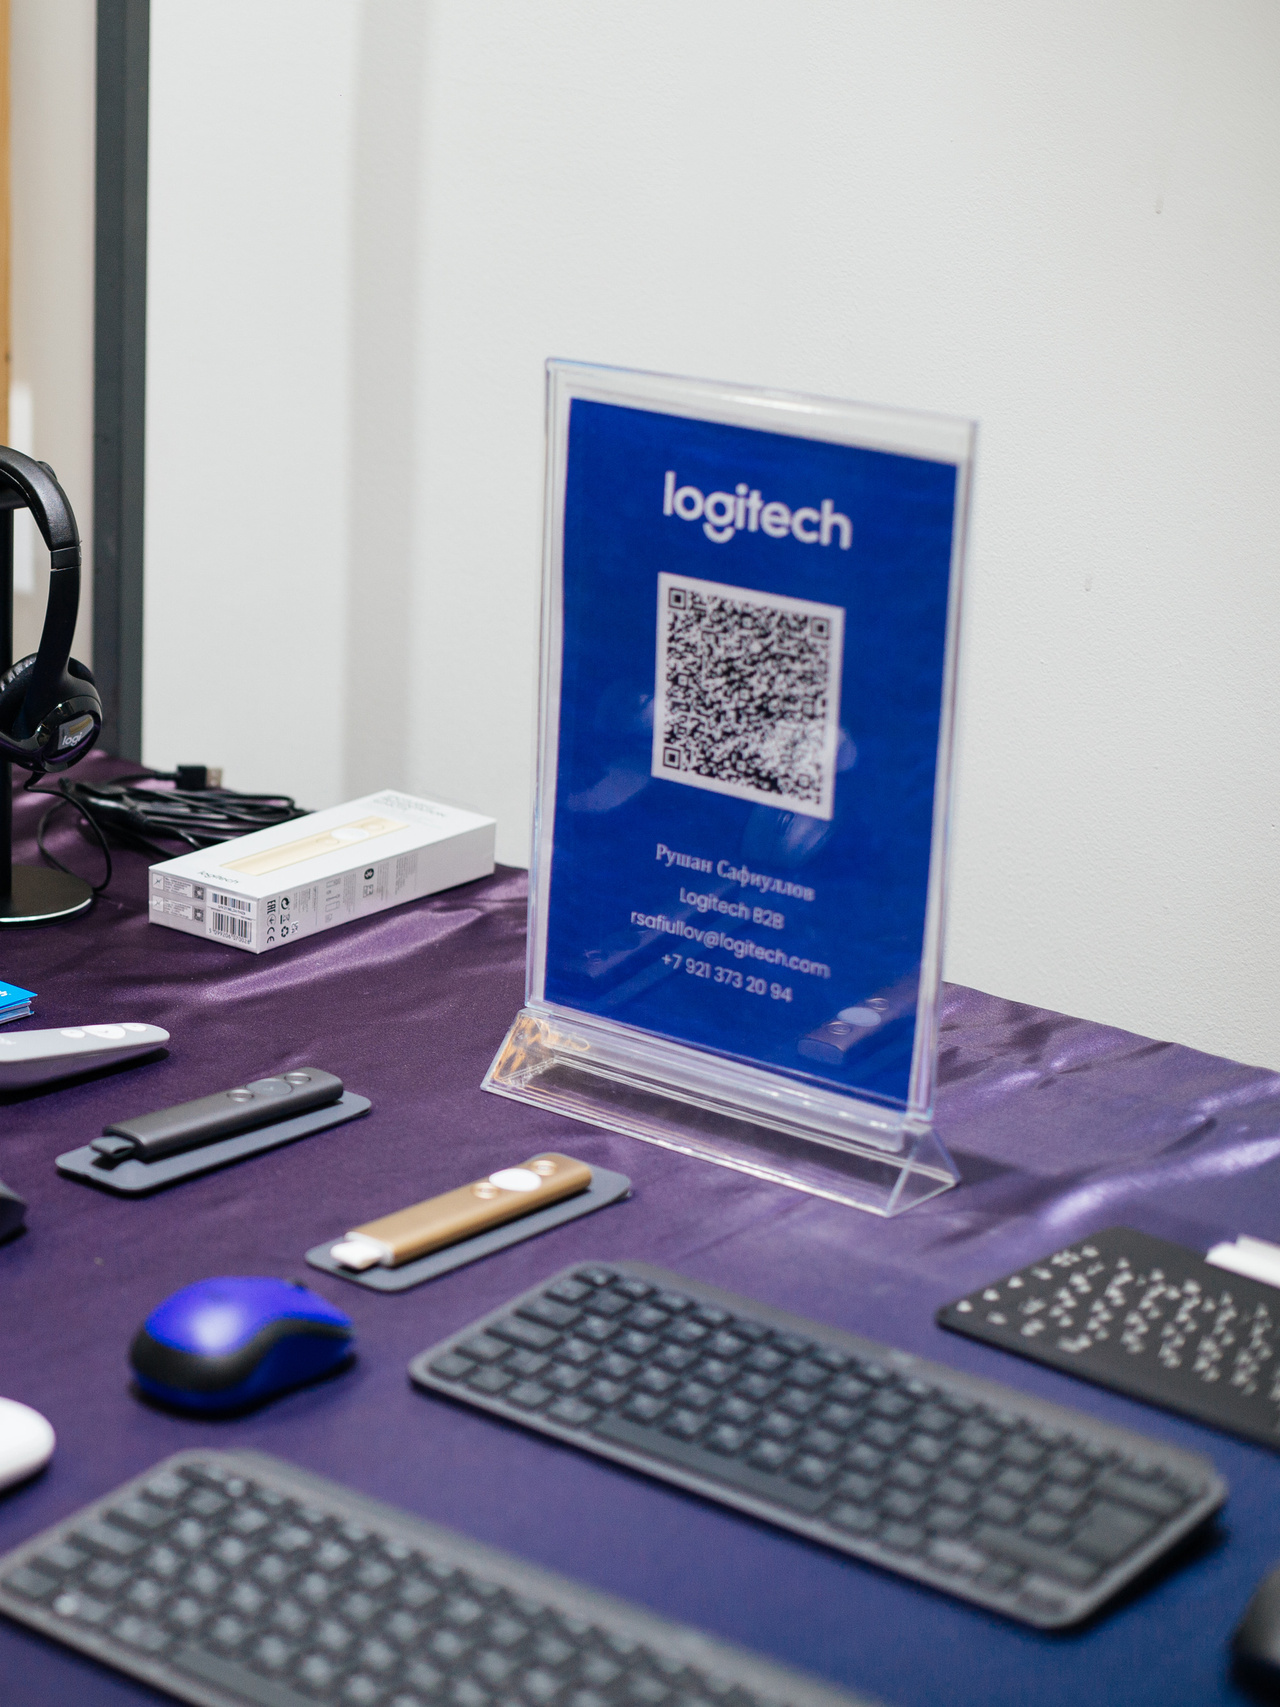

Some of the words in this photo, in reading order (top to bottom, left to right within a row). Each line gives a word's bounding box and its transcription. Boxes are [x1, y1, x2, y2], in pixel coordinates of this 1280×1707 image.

[663, 470, 853, 550] logitech
[61, 731, 83, 747] logi
[655, 843, 713, 874] Рушан
[716, 859, 816, 902] Сафиуллов
[679, 887, 751, 921] Logitech
[752, 907, 786, 930] B2B
[630, 909, 832, 979] rsafiullov@logitech.com
[661, 953, 683, 970] +7
[685, 957, 712, 979] 921
[713, 966, 743, 989] 373
[745, 975, 767, 996] 20
[769, 982, 793, 1003] 94
